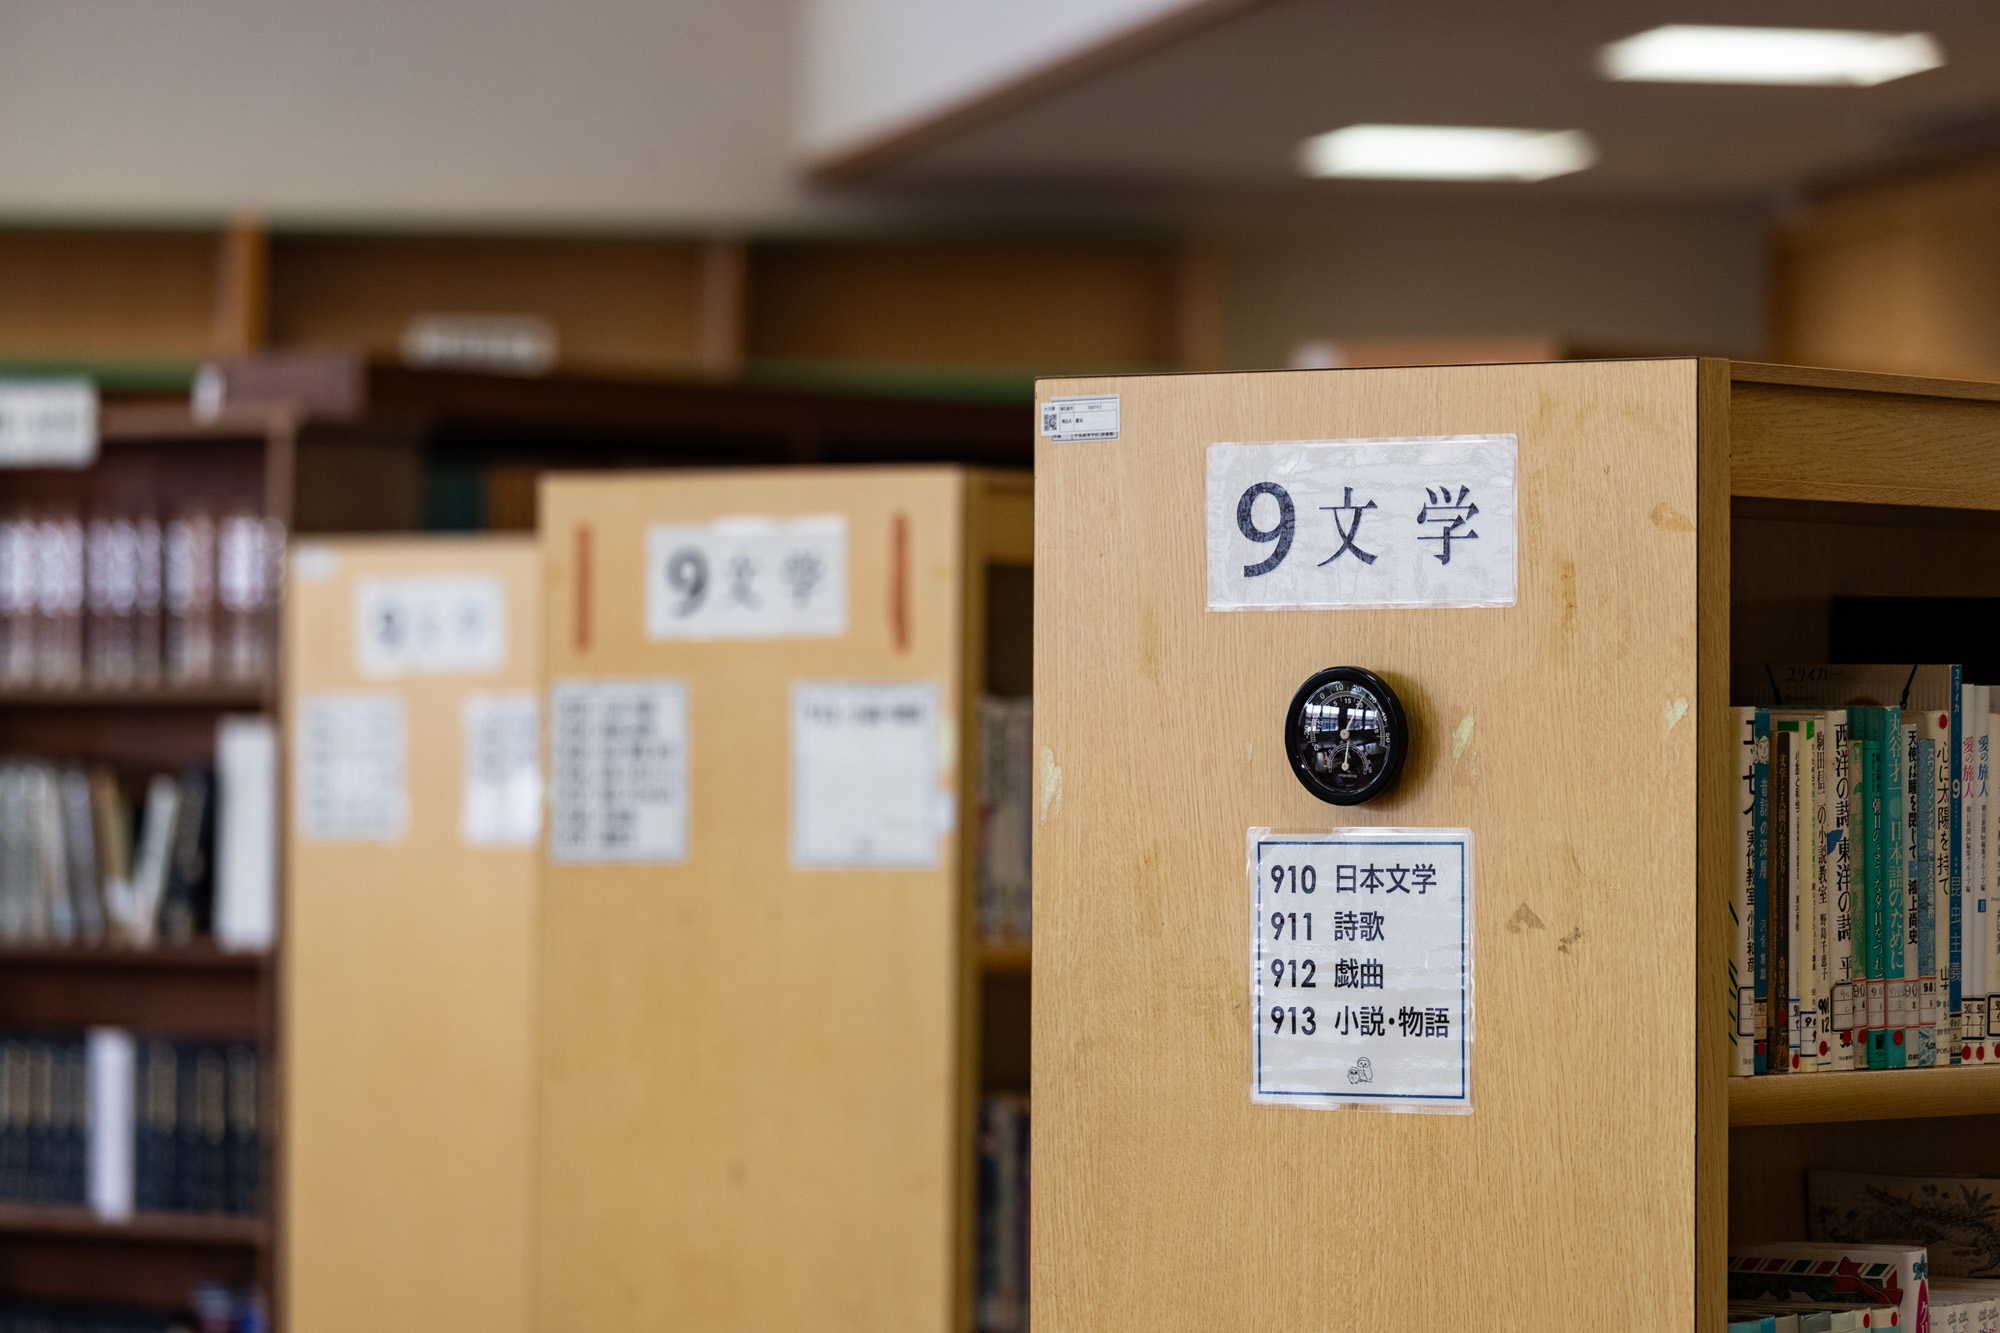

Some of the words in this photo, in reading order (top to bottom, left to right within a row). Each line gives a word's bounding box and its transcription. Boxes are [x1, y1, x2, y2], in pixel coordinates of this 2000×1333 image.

[1237, 482, 1295, 577] 9
[1317, 484, 1479, 566] 文学
[665, 546, 710, 619] 9
[1352, 685, 1362, 693] 20
[1888, 713, 1903, 791] 丸谷才一
[1963, 736, 1974, 799] 愛の旅人
[1978, 735, 1989, 798] 愛の旅人
[1937, 741, 1949, 896] 心に太陽を持て
[1952, 778, 1961, 799] 9
[1271, 865, 1317, 894] 910
[1336, 863, 1437, 894] 日本文学
[1888, 821, 1904, 971] 日本語のために
[1271, 912, 1312, 941] 911
[1334, 911, 1385, 942] 詩歌
[1271, 959, 1317, 988] 912
[1334, 958, 1384, 989] 戯曲
[1271, 1006, 1317, 1035] 913
[1334, 1006, 1450, 1038] 小説・物語
